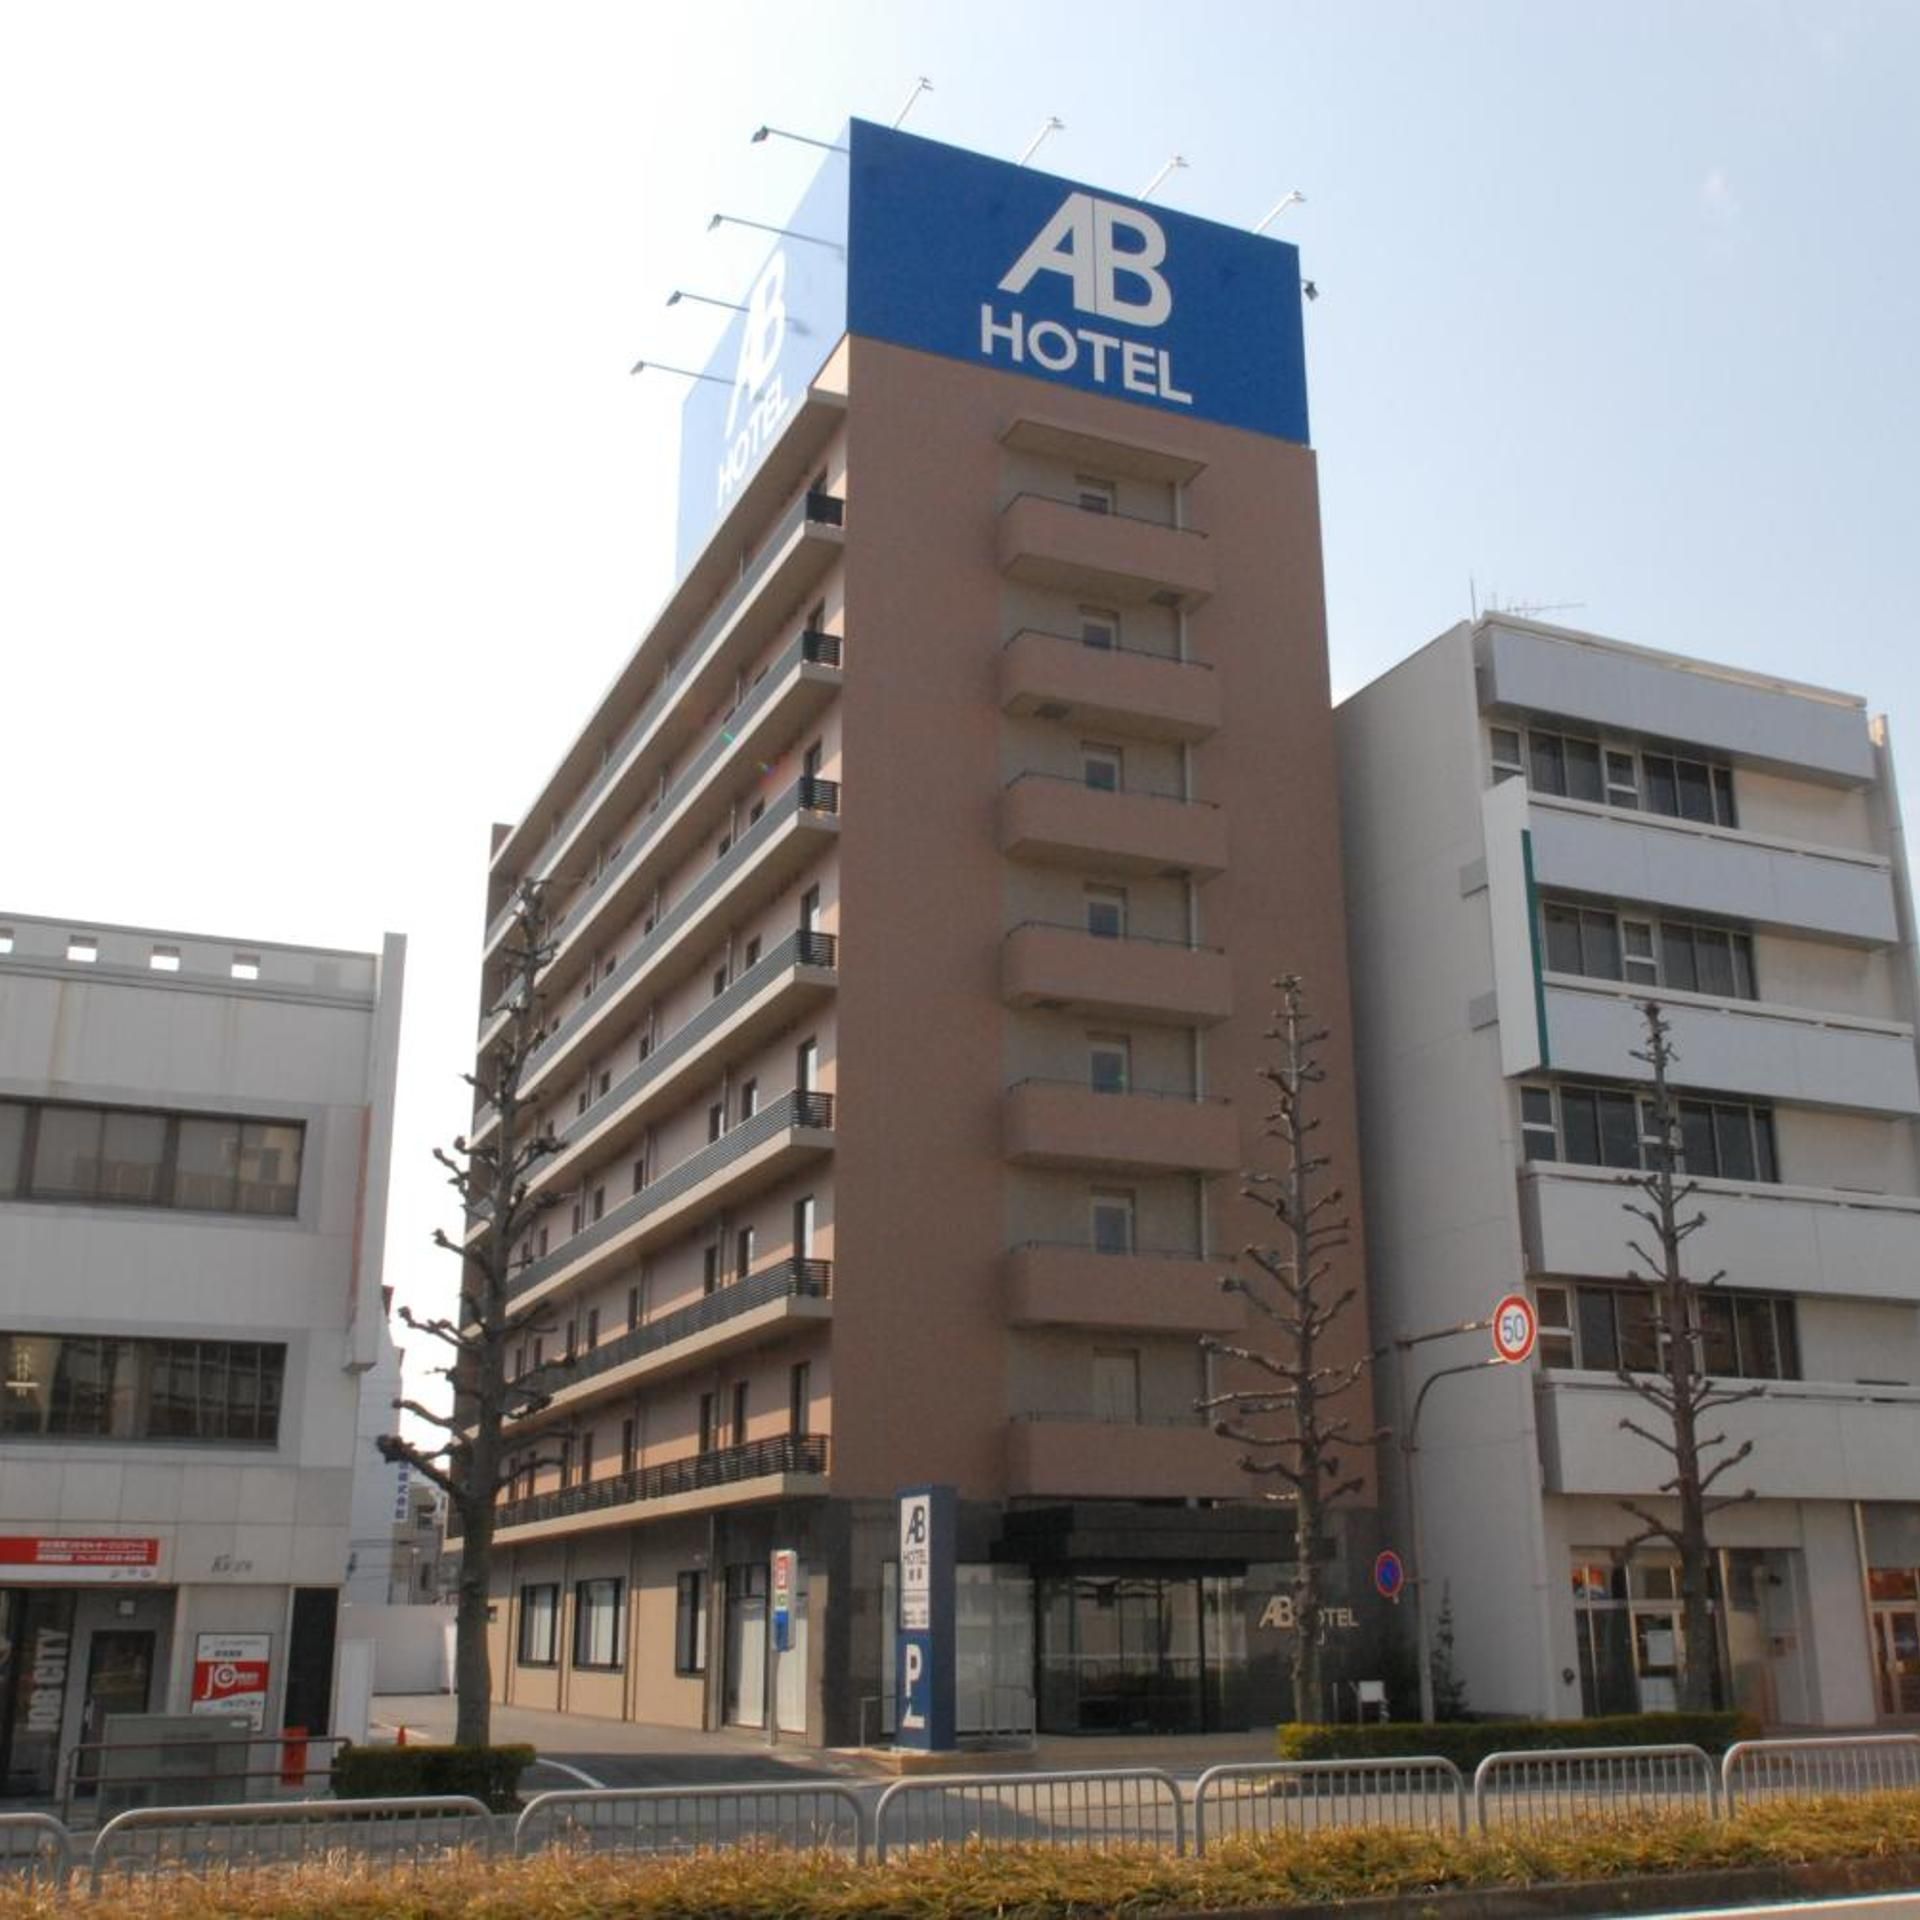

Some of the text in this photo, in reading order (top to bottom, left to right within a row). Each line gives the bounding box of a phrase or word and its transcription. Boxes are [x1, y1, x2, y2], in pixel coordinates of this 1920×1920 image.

[997, 191, 1173, 328] AB
[980, 303, 1193, 405] HOTEL
[717, 372, 789, 508] HOTEL
[1503, 1314, 1526, 1344] 50
[905, 1505, 925, 1544] AB
[903, 1549, 927, 1565] HOTEL
[1259, 1595, 1360, 1628] AB TEL
[33, 1628, 68, 1684] CITY
[906, 1644, 922, 1698] P
